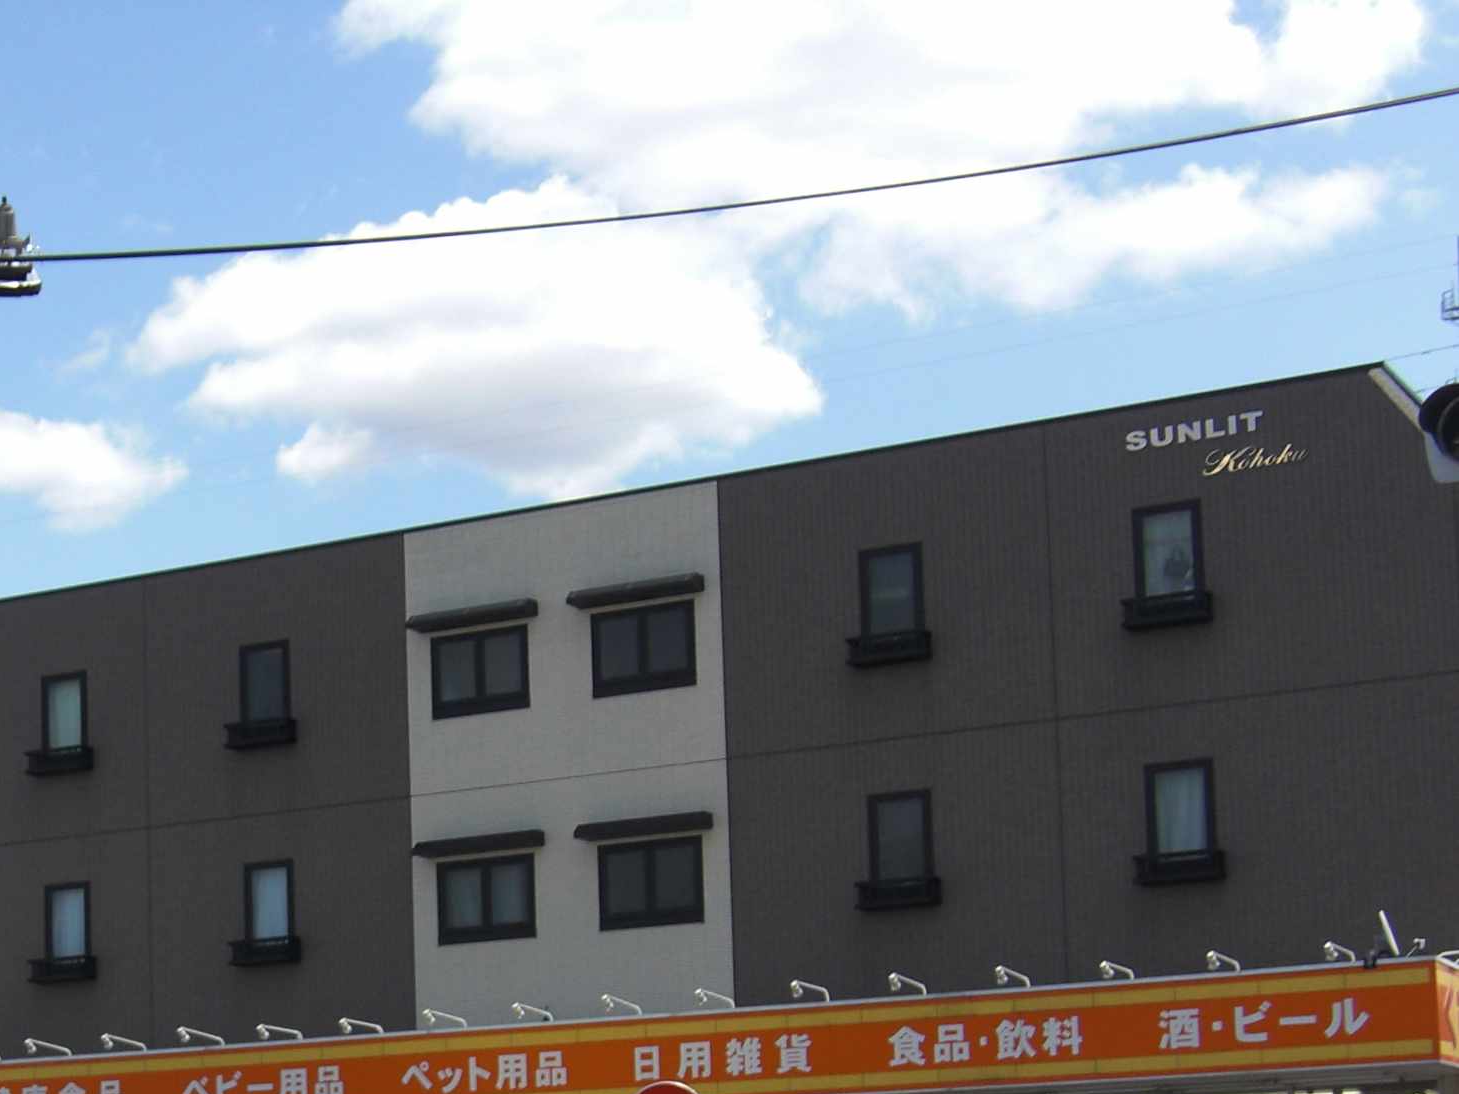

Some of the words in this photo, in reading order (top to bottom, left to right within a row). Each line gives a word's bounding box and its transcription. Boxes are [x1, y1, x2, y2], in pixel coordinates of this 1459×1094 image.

[1125, 410, 1263, 451] SUNLIT
[401, 1051, 567, 1094] ペット用品
[634, 1033, 812, 1081] 日用雑貨
[888, 1016, 1082, 1068] 食品・飲料
[1158, 998, 1370, 1050] 酒・ビール
